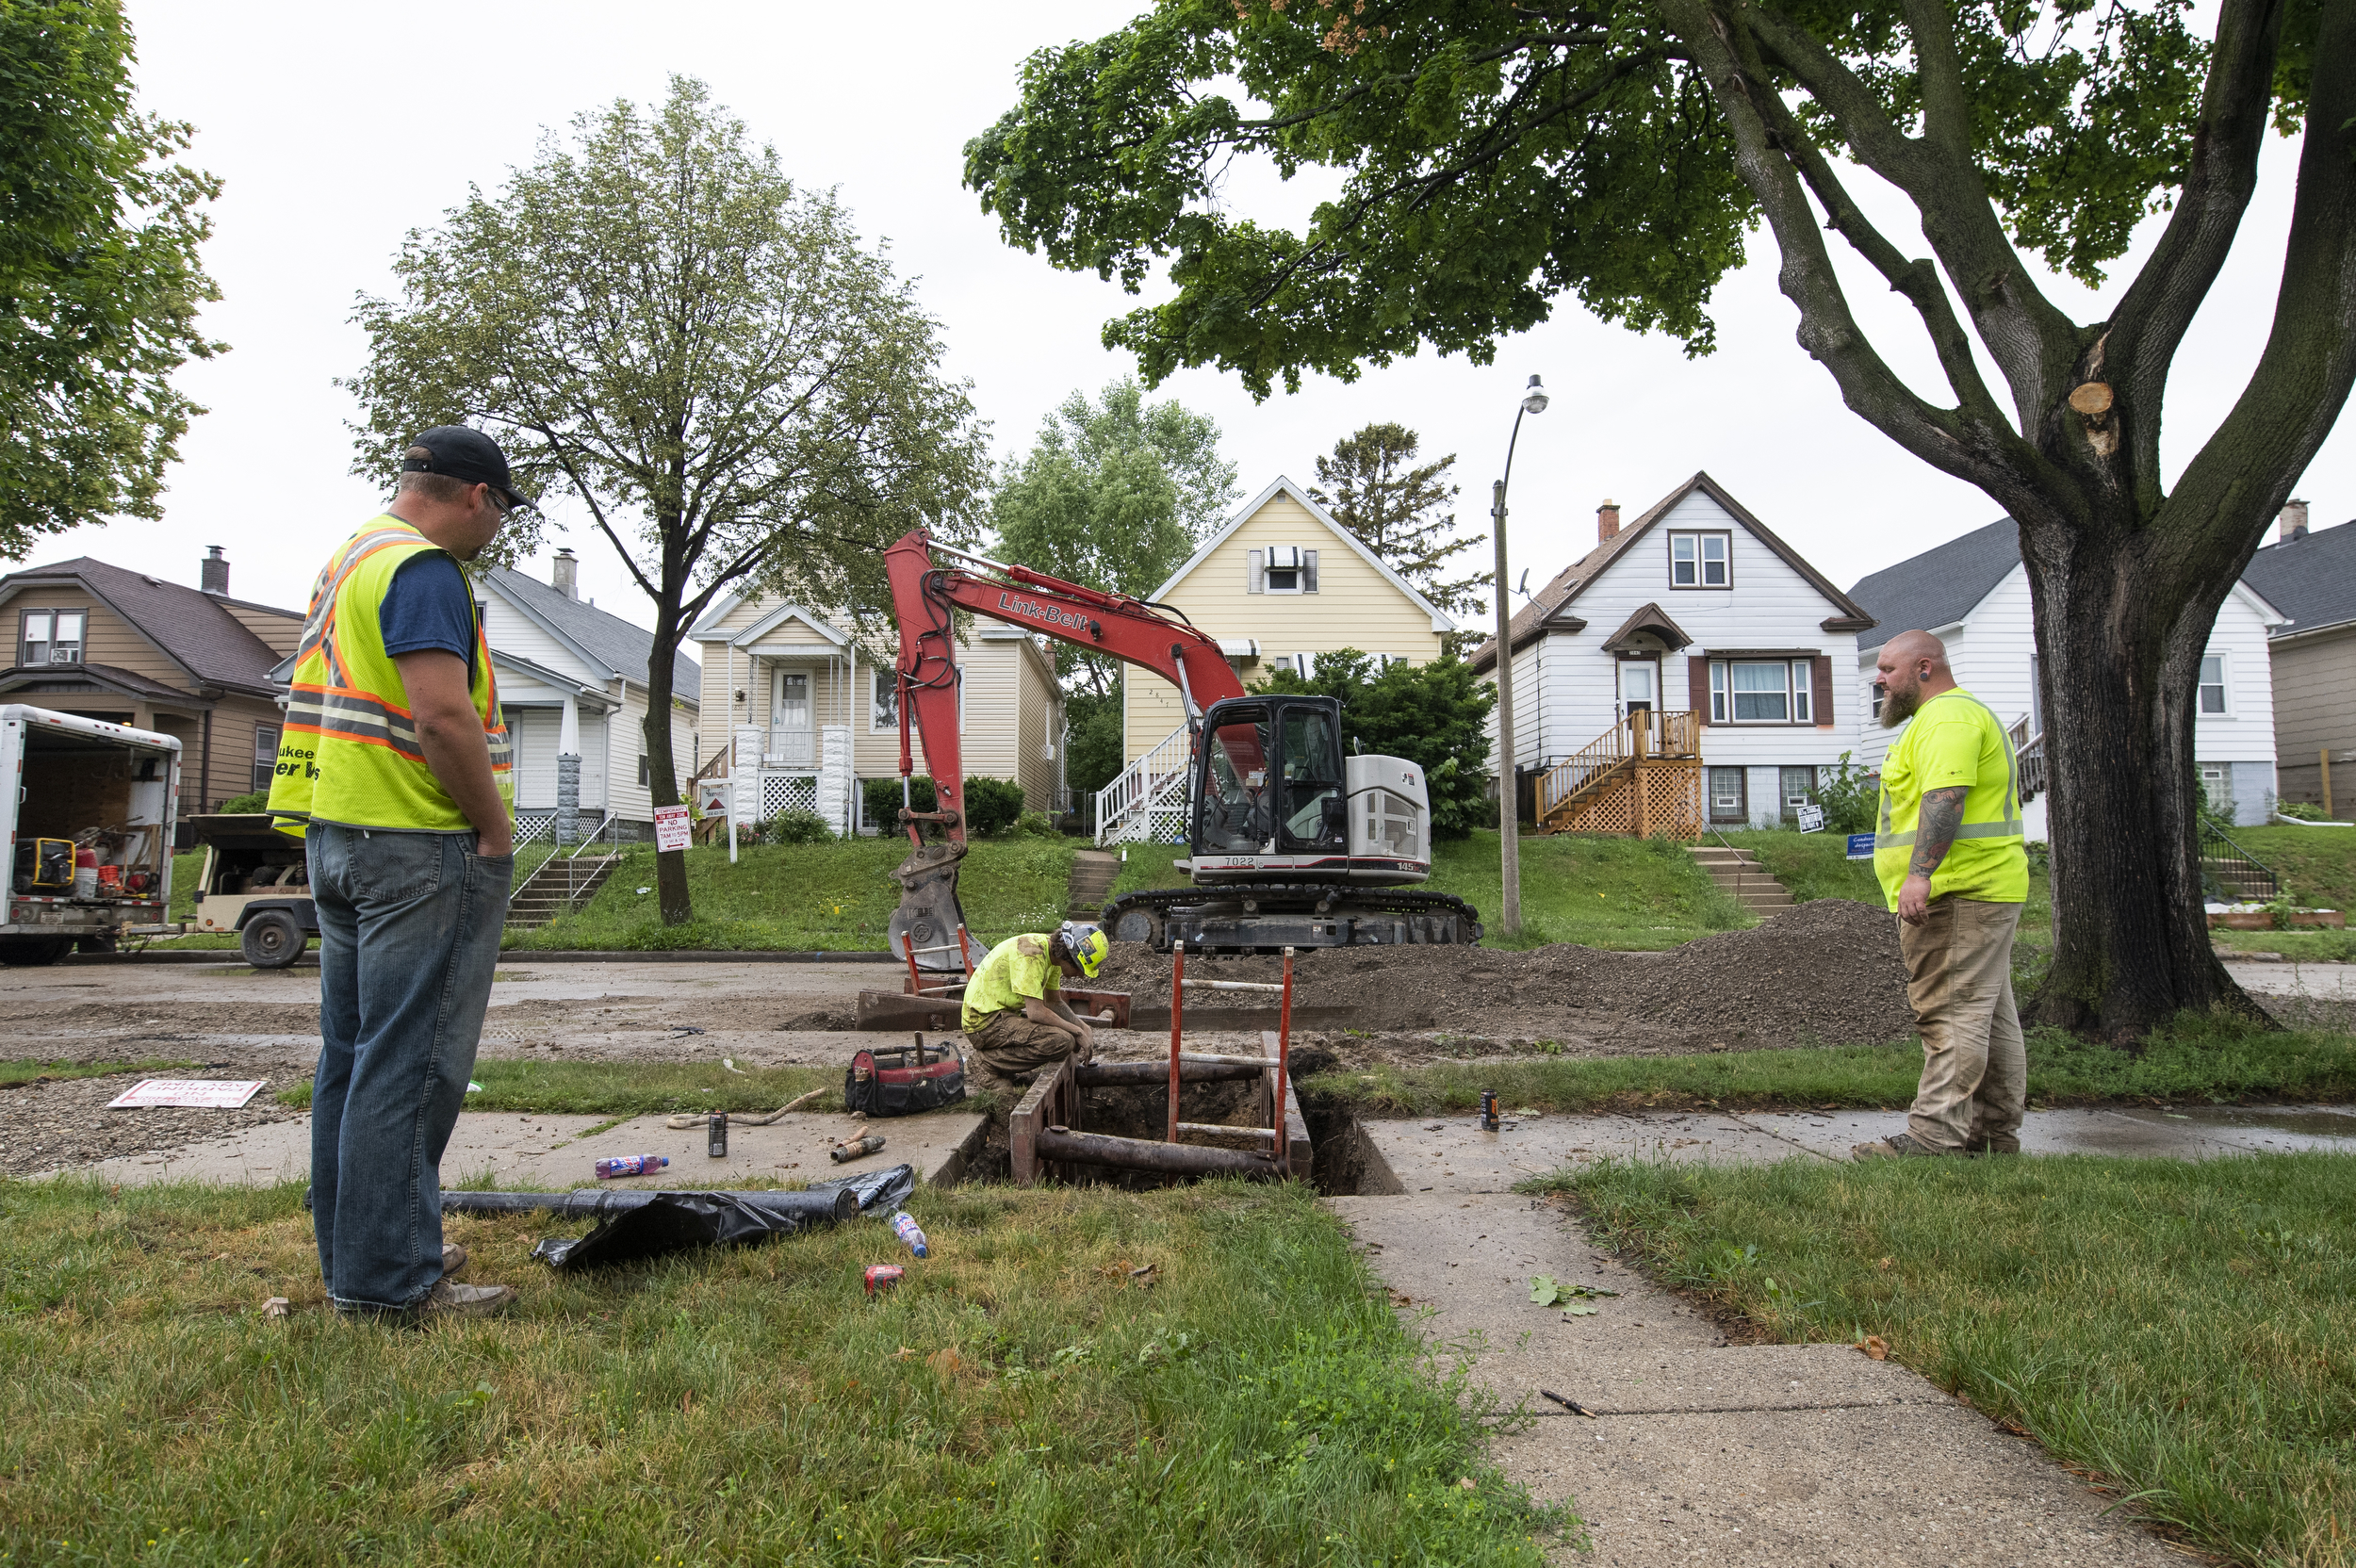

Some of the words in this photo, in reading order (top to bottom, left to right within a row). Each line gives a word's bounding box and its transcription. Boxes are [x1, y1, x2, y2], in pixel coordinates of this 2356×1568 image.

[998, 592, 1088, 631] Link-Belt
[660, 825, 687, 833] PARKING
[1225, 857, 1254, 866] 7022
